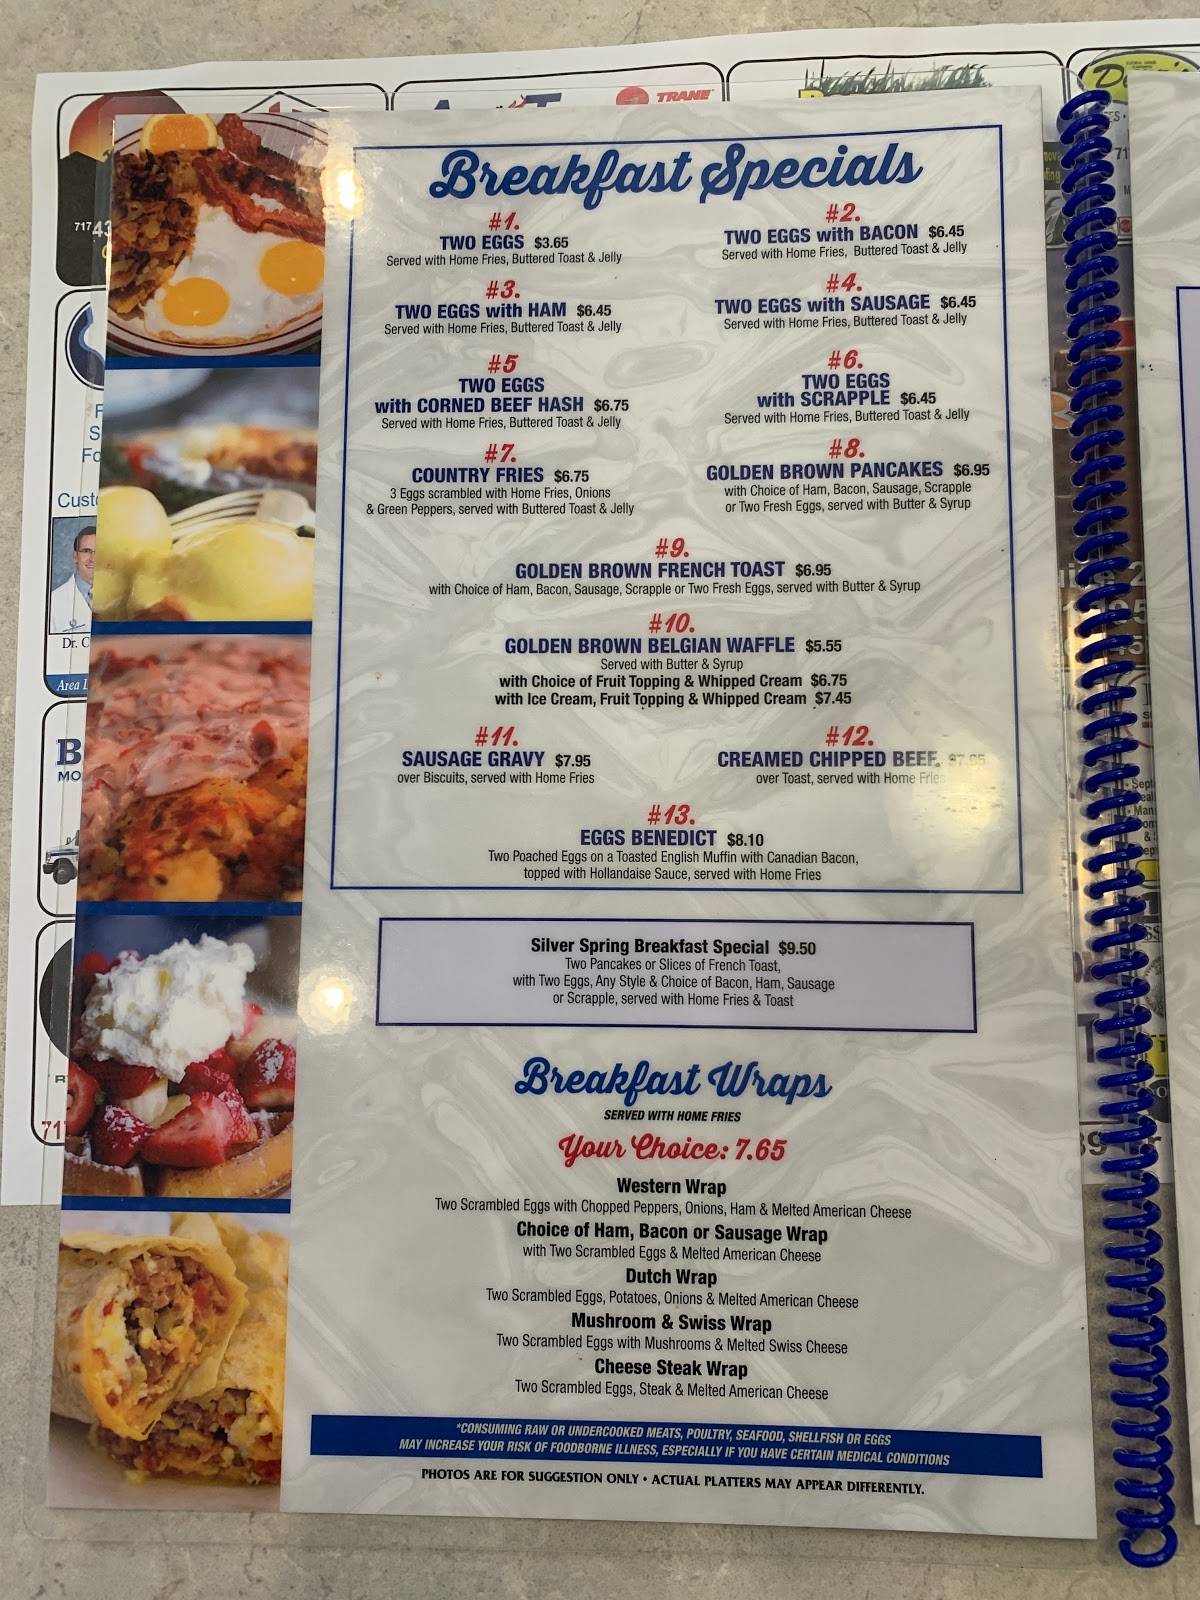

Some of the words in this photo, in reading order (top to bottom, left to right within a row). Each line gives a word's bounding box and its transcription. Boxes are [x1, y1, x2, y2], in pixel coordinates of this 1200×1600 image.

[657, 89, 712, 103] TRANE
[429, 149, 693, 210] Breakfast
[699, 143, 924, 204] Specials
[488, 211, 519, 231] #1.
[825, 202, 860, 223] #2.
[74, 221, 92, 231] 717
[723, 229, 761, 245] TWO
[767, 227, 810, 243] EGGS
[816, 226, 853, 242] with
[859, 223, 918, 241] BACON
[928, 224, 964, 239] $6.45
[439, 235, 476, 250] TWO
[482, 234, 524, 249] EGGS
[534, 236, 568, 249] $3.65
[386, 255, 421, 266] Served
[424, 254, 445, 265] with
[449, 254, 478, 265] Home
[481, 253, 508, 266] Fries,
[512, 252, 554, 264] Buttered
[557, 252, 584, 263] Toast
[587, 251, 595, 262] &
[598, 251, 622, 264] Jelly
[485, 279, 520, 299] #3.
[826, 272, 862, 293] #4.
[394, 304, 431, 319] TWO
[437, 303, 480, 319] EGGS
[485, 303, 522, 318] with
[528, 302, 566, 317] HAM
[576, 303, 611, 318] $6.45
[714, 298, 752, 314] TWO
[758, 297, 801, 313] EGGS
[807, 296, 844, 312] with
[850, 293, 930, 311] SAUSAGE
[940, 295, 976, 310] $6.45
[487, 354, 519, 374] #5
[827, 349, 863, 369] #6.
[458, 377, 495, 393] TWO
[501, 377, 544, 392] EGGS
[801, 373, 839, 389] TWO
[845, 372, 890, 388] EGGS
[374, 398, 411, 413] with
[417, 397, 484, 413] CORNED
[490, 397, 532, 412] BEEF
[538, 396, 583, 412] HASH
[593, 398, 629, 412] $6.75
[756, 391, 794, 407] with
[800, 389, 890, 406] SCRAPPLE
[900, 391, 936, 406] $6.45
[484, 443, 516, 463] #7.
[828, 438, 864, 459] #8.
[411, 467, 490, 483] COUNTRY
[496, 466, 544, 482] FRIES
[554, 469, 589, 483] $6.75
[706, 464, 773, 481] GOLDEN
[780, 462, 844, 479] BROWN
[850, 460, 943, 478] PANCAKES
[953, 462, 990, 477] $6.95
[654, 537, 689, 558] #9.
[515, 562, 582, 579] GOLDEN
[588, 562, 651, 578] BROWN
[658, 561, 725, 578] FRENCH
[730, 560, 785, 577] TOAST
[795, 563, 831, 578] $6.95
[648, 612, 695, 634] #10.
[62, 638, 78, 649] Dr.
[505, 637, 572, 654] GOLDEN
[578, 637, 641, 654] BROWN
[648, 637, 721, 653] BELGIAN
[726, 636, 795, 653] WAFFLE
[805, 638, 842, 654] $5.55
[57, 679, 80, 691] Area
[474, 726, 518, 746] #11.
[825, 725, 874, 746] #12.
[401, 750, 482, 767] SAUSAGE
[487, 750, 544, 767] GRAVY
[554, 753, 590, 768] $7.95
[717, 751, 803, 767] CREAMED
[809, 750, 886, 767] CHIPPED
[647, 804, 695, 825] #13.
[580, 829, 625, 845] EGGS
[631, 829, 717, 846] BENEDICT
[727, 832, 764, 848] $8.10
[531, 937, 575, 952] Silver
[579, 937, 629, 956] Spring
[634, 938, 708, 953] Breakfast
[713, 939, 769, 957] Special
[778, 940, 816, 956] $9.50
[514, 1056, 701, 1107] Breakfast
[707, 1060, 832, 1105] Wraps
[603, 1109, 645, 1120] SERVED
[647, 1110, 674, 1120] WITH
[676, 1110, 708, 1121] HOME
[710, 1111, 741, 1122] FRIES
[558, 1133, 626, 1167] Your
[630, 1132, 728, 1160] Choice:
[735, 1138, 787, 1161] 7.65
[616, 1177, 681, 1193] Western
[685, 1178, 726, 1198] Wrap
[434, 1197, 457, 1210] Two
[460, 1197, 519, 1211] Scrambled
[523, 1198, 550, 1214] Eggs
[553, 1199, 577, 1212] with
[581, 1199, 629, 1215] Chopped
[633, 1200, 681, 1216] Peppers,
[685, 1200, 726, 1216] Onions,
[730, 1201, 755, 1215] Ham
[759, 1202, 768, 1215] &
[771, 1202, 809, 1216] Melted
[812, 1203, 866, 1217] American
[870, 1204, 911, 1218] Cheese
[626, 1267, 671, 1283] Dutch
[675, 1268, 717, 1288] Wrap
[571, 1311, 655, 1329] Mushroom
[661, 1313, 673, 1329] &
[678, 1313, 726, 1331] Swiss
[730, 1315, 772, 1335] Wrap
[594, 1357, 651, 1374] Cheese
[656, 1359, 702, 1375] Steak
[706, 1360, 747, 1380] Wrap
[524, 1424, 549, 1435] RAW
[550, 1424, 565, 1435] OR
[567, 1425, 643, 1437] UNDERCOOKED
[646, 1427, 683, 1440] MEATS,
[686, 1428, 732, 1442] POULTRY,
[735, 1429, 785, 1443] SEAFOOD,
[788, 1430, 844, 1443] SHELLFISH
[846, 1432, 861, 1444] OR
[863, 1433, 891, 1445] EGGS
[421, 1468, 470, 1479] PHOTOS
[473, 1469, 497, 1480] ARE
[501, 1470, 524, 1481] FOR
[528, 1470, 602, 1483] SUGGESTION
[606, 1472, 639, 1484] ONLY
[651, 1474, 700, 1486] ACTUAL
[704, 1475, 761, 1488] PLATTERS
[764, 1477, 791, 1489] MAY
[795, 1478, 843, 1491] APPEAR
[847, 1480, 924, 1494] DIFFERENTLY.
